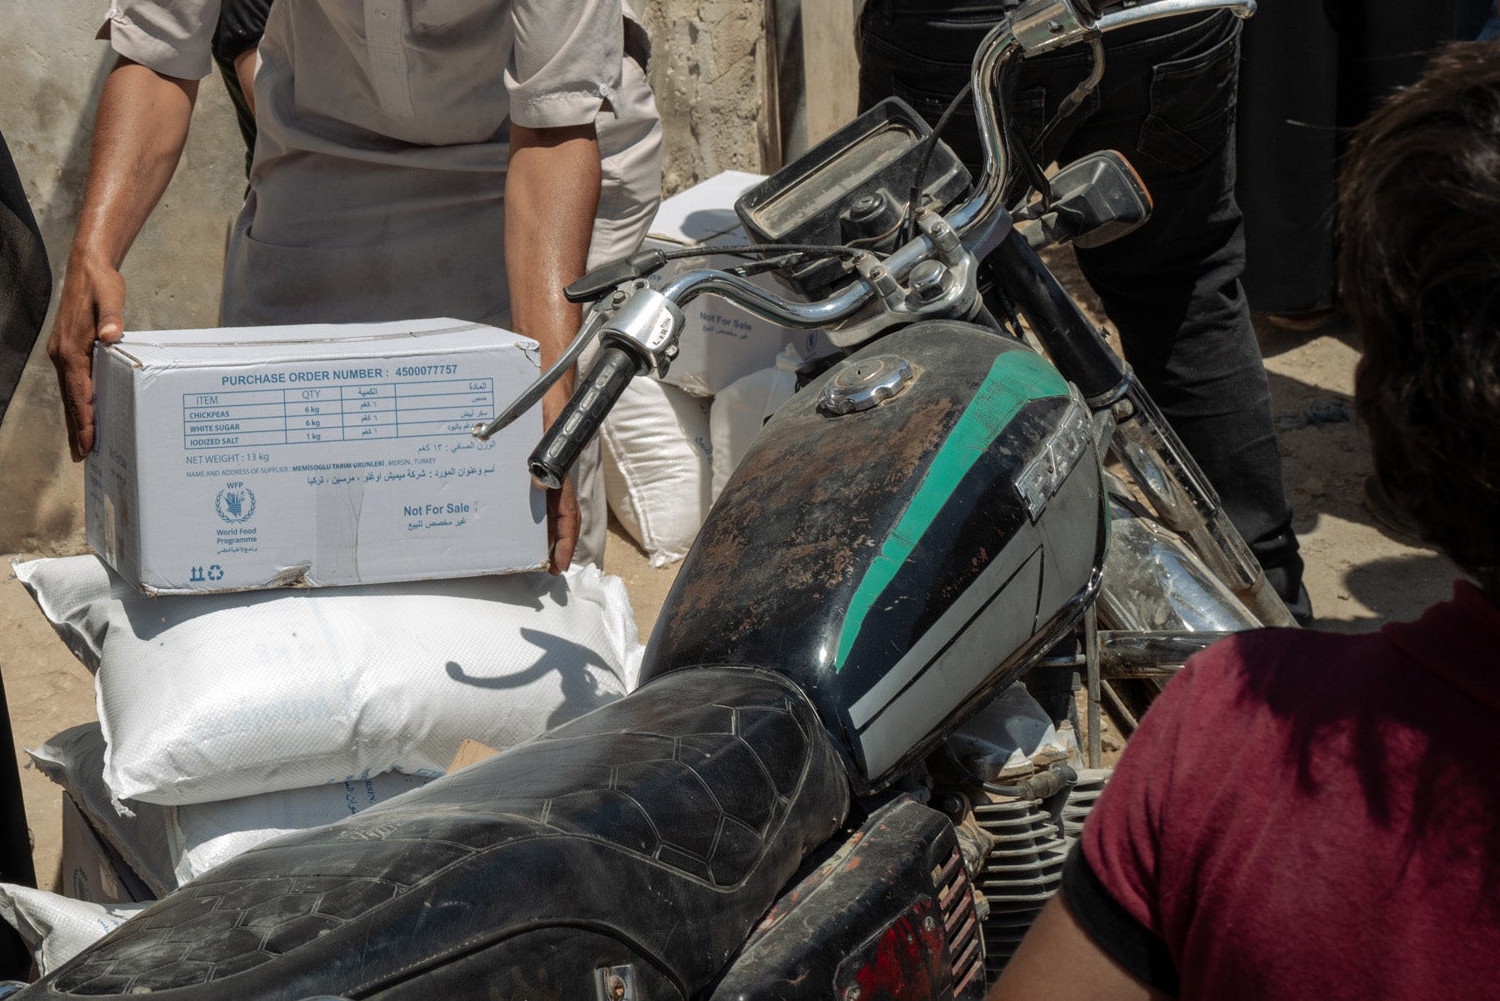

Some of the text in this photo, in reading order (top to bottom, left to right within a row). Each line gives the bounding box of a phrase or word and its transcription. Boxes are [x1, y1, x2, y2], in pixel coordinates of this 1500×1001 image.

[701, 312, 752, 331] Not For Sale
[222, 373, 286, 386] PURCHASE
[288, 370, 330, 382] ORDER
[333, 368, 383, 380] NUMBER
[395, 364, 458, 377] 4500077757
[469, 381, 487, 391] المادة
[302, 389, 321, 400] QTY
[358, 387, 378, 398] الكمية
[196, 395, 219, 405] ITEM
[189, 410, 230, 419] CHICKPEAS
[311, 405, 319, 414] kg
[190, 423, 240, 433] WHITE SUGAR
[305, 419, 321, 427] 6 kg
[190, 437, 239, 446] IODIZED SALT
[311, 432, 321, 441] kg
[451, 442, 475, 453] الصافي
[186, 455, 203, 464] NET
[204, 453, 240, 463] WEIGHT
[246, 453, 257, 461] 13
[258, 451, 269, 462] kg
[186, 471, 204, 479] NAME
[205, 469, 220, 477] AND
[221, 468, 250, 476] ADDRESS
[260, 466, 288, 474] SUPPLIER
[332, 462, 352, 470] TARIM
[414, 457, 436, 465] TURKEY
[435, 467, 456, 478] المورد
[407, 469, 426, 479] شركة
[307, 475, 324, 486] تركيا
[332, 474, 355, 485] مرسين
[226, 481, 243, 489] WFP
[403, 502, 470, 517] Not For Sale
[407, 517, 466, 530] غير مخصص للبيع
[216, 527, 257, 536] World Food
[216, 536, 257, 545] Programme
